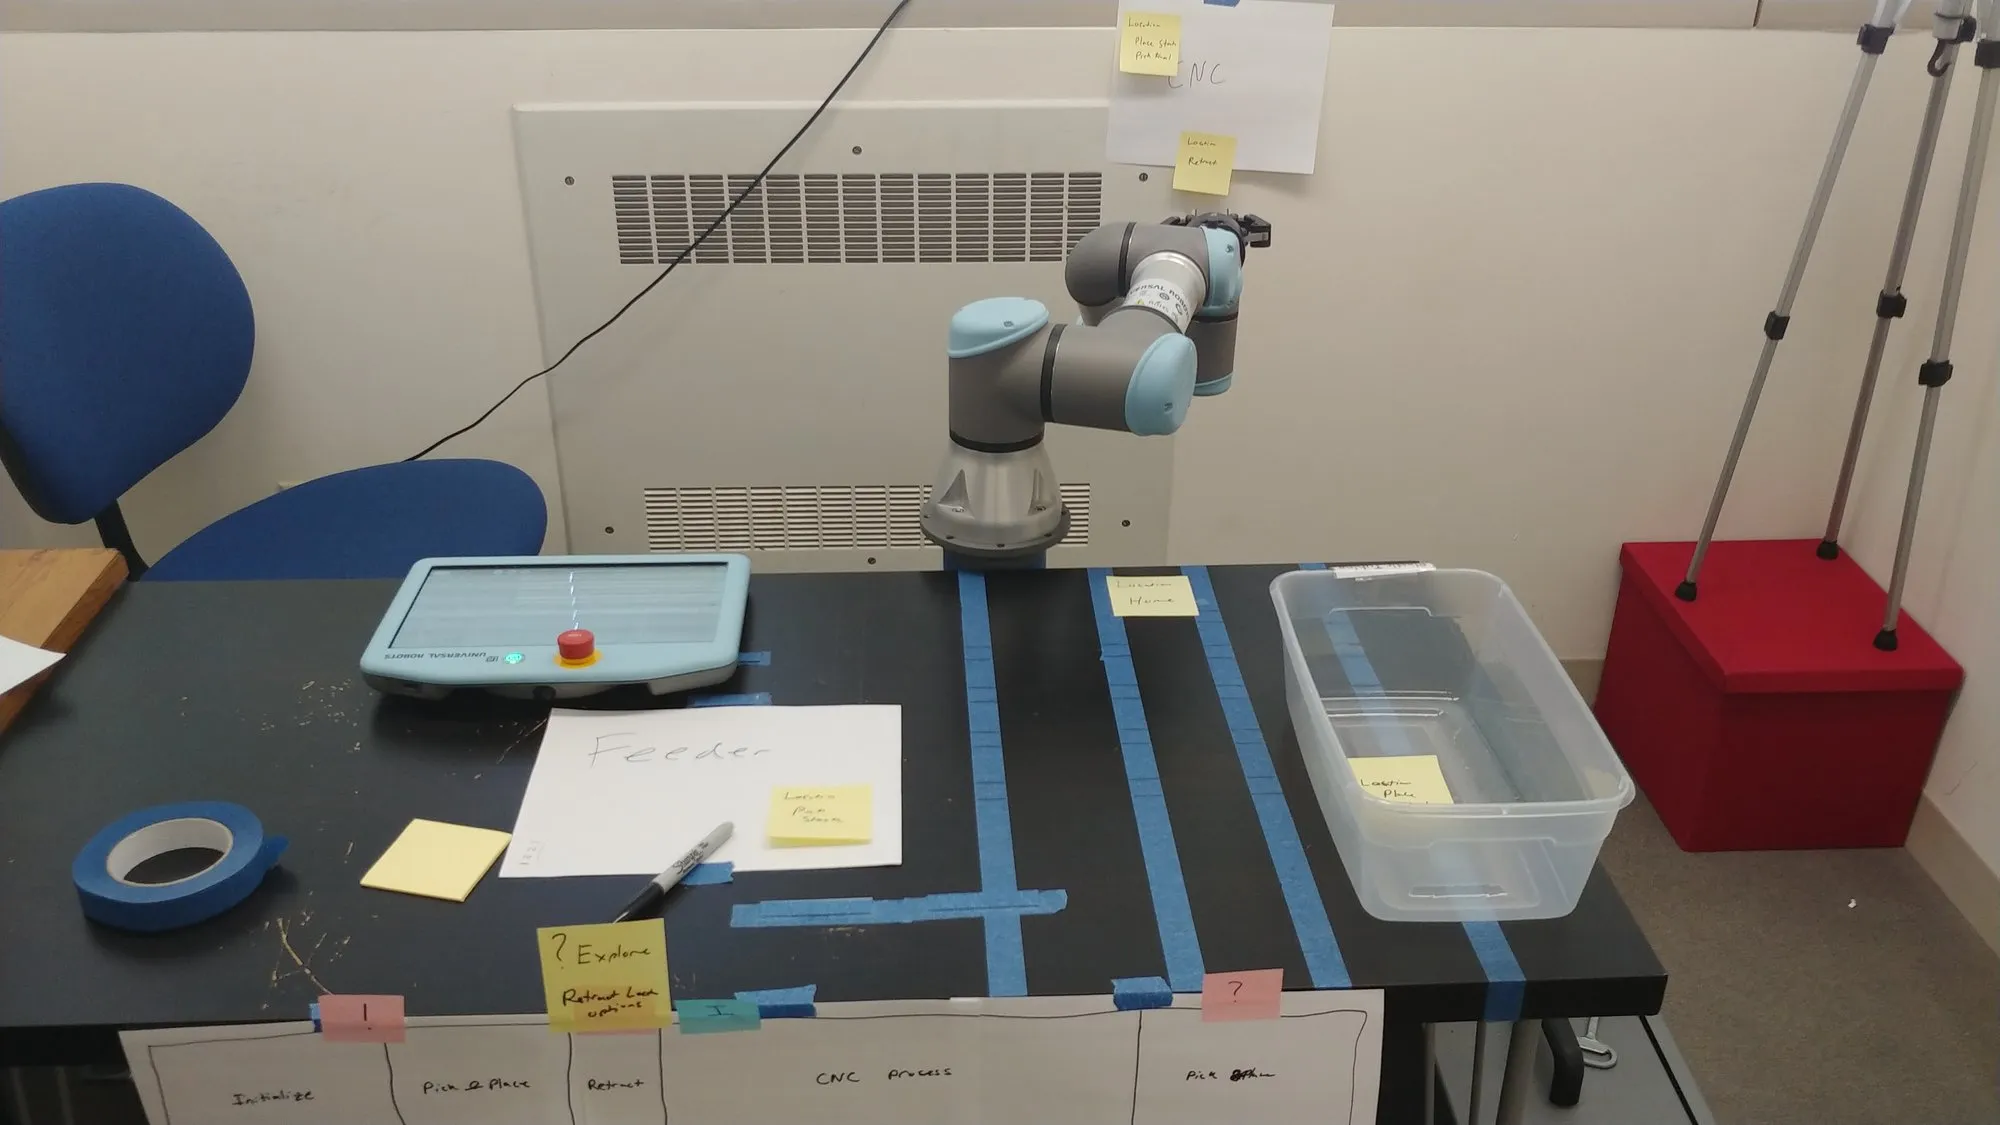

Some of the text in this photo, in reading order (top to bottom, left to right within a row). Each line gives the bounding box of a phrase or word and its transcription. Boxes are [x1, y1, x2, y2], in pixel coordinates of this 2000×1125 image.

[1188, 156, 1218, 166] Retract
[1129, 596, 1175, 606] Home
[427, 652, 487, 660] UNIVERSAL
[588, 731, 773, 769] Feeder
[551, 932, 652, 970] ? Explore
[562, 987, 621, 1006] Retract
[1227, 980, 1243, 1004] ?
[815, 1071, 861, 1085] CNC
[1185, 1070, 1218, 1081] Pick
[423, 1080, 459, 1094] Pick
[488, 1078, 533, 1091] Place
[587, 1078, 645, 1092] Retract
[231, 1089, 315, 1107] Initialize
